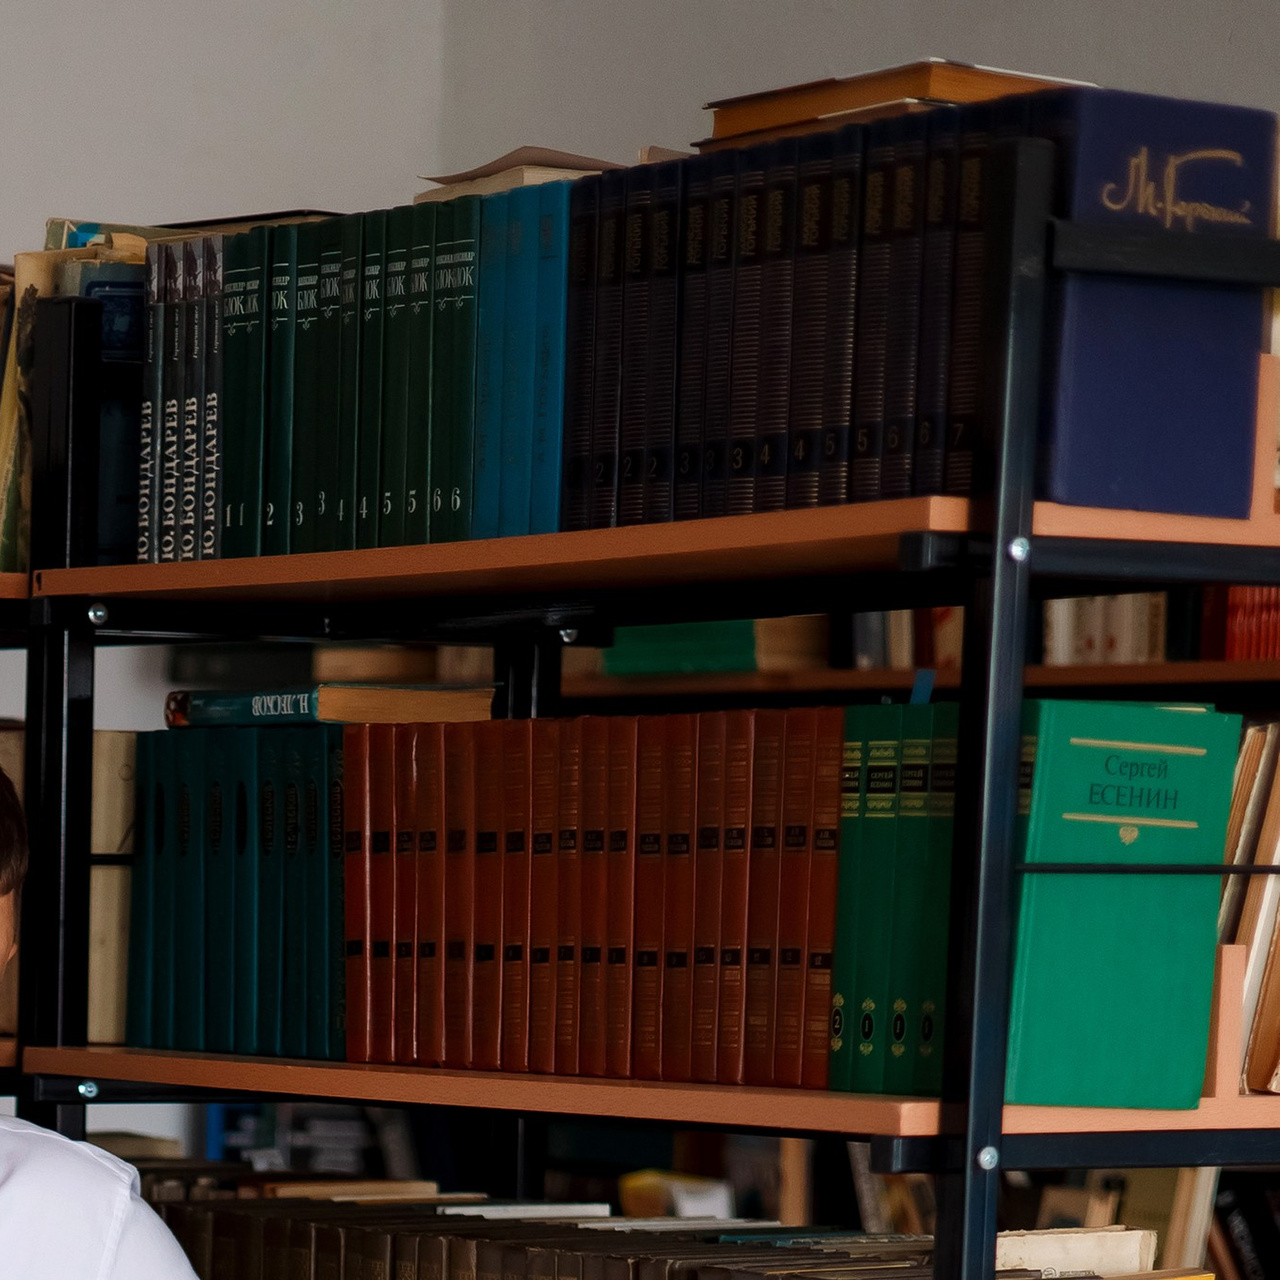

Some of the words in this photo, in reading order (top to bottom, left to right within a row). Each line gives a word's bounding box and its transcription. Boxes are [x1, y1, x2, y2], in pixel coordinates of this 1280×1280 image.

[794, 441, 805, 462] 4
[857, 431, 869, 452] 5
[138, 401, 152, 527] БОНДАРЕВ
[162, 398, 178, 526] БОНДАРЕВ
[181, 397, 198, 525] БОНДАРЕВ
[204, 392, 218, 521] БОНДАРЕВ
[680, 454, 690, 474] 3
[732, 449, 743, 470] 3
[760, 446, 771, 466] 4
[318, 491, 326, 516] 3
[337, 498, 344, 521] 4
[359, 496, 368, 519] 4
[383, 492, 392, 515] 5
[408, 489, 417, 513] 5
[433, 488, 442, 512] 6
[451, 487, 461, 512] 6
[225, 504, 232, 527] 1
[266, 502, 274, 526] 2
[296, 502, 304, 526] 3
[137, 531, 149, 560] Ю.
[161, 531, 175, 560] Ю.
[180, 530, 195, 559] Ю.
[203, 526, 215, 555] Ю.
[252, 695, 296, 716] ЛЕСКОВ
[1105, 755, 1169, 780] Сергей
[1088, 783, 1179, 810] ЕСЕНИН
[833, 1016, 840, 1030] 2
